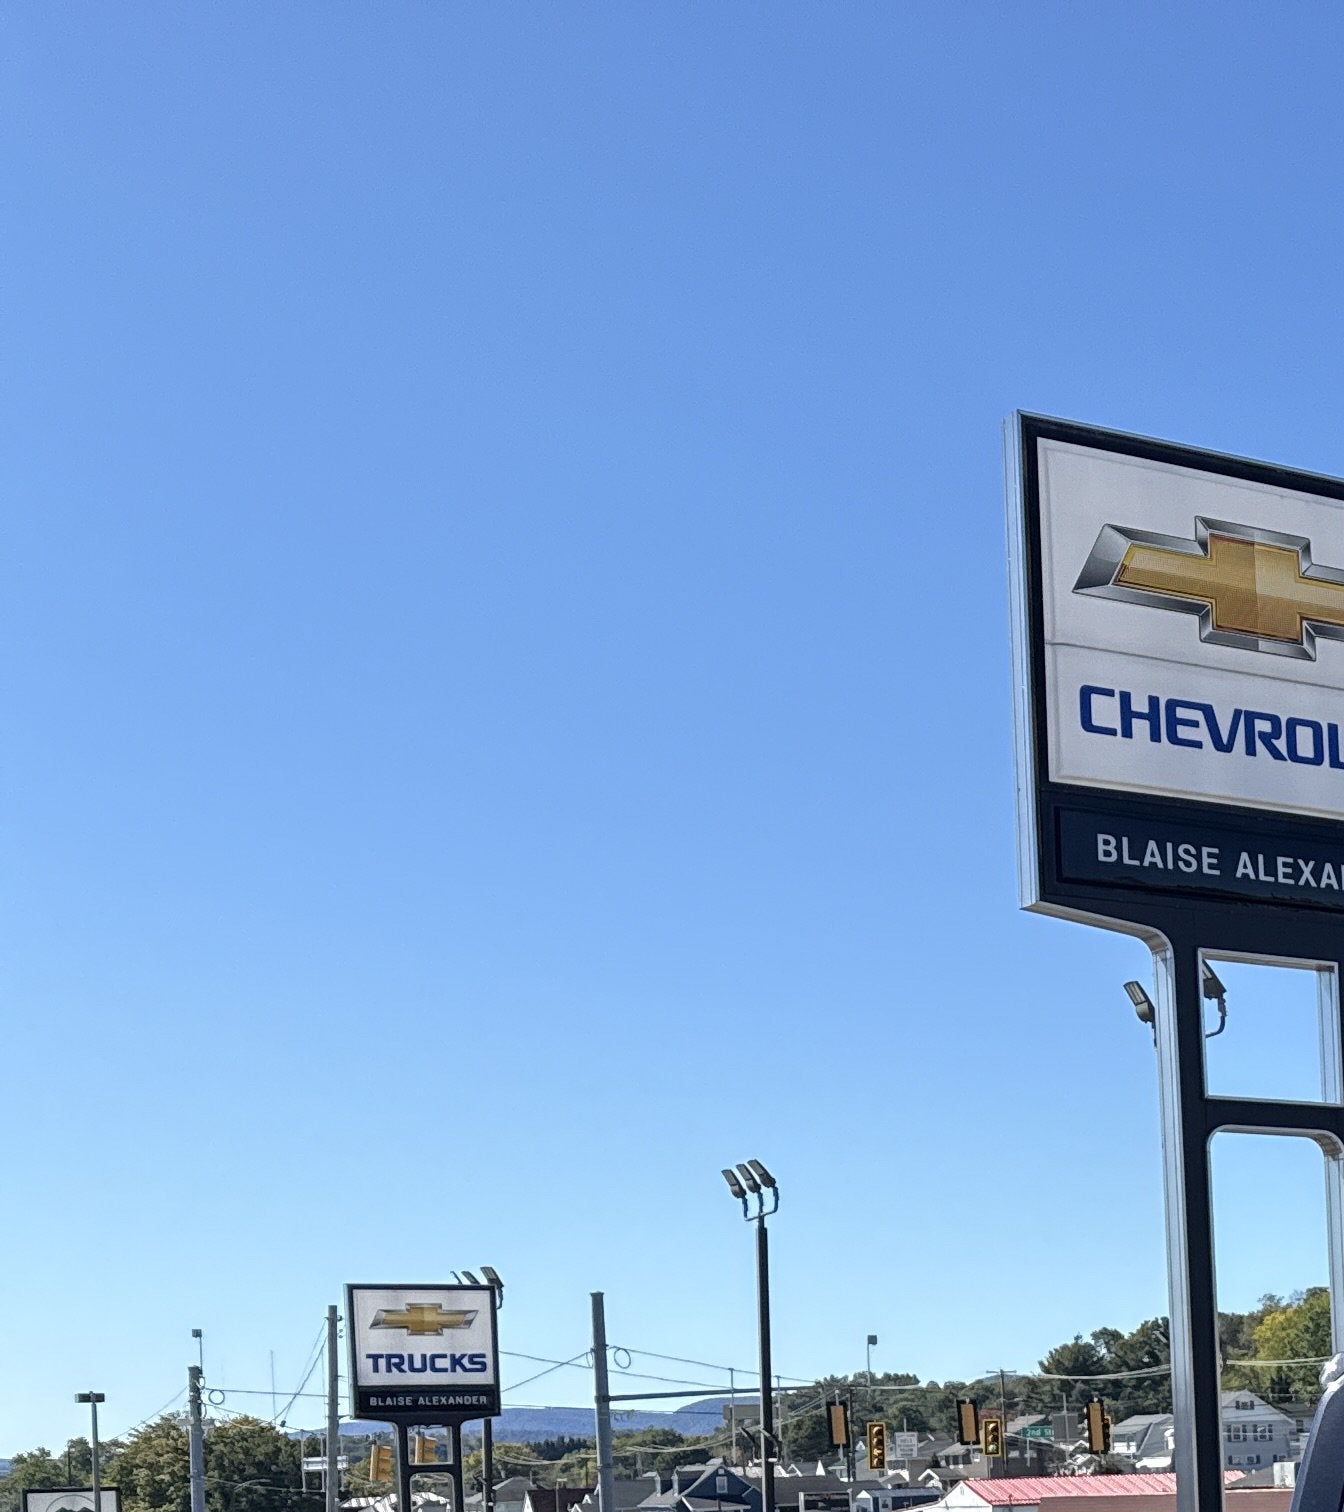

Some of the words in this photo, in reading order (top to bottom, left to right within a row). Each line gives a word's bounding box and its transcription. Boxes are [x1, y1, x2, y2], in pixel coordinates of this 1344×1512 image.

[1096, 832, 1222, 877] BLAISE
[366, 1353, 488, 1374] TRUCKS
[369, 1396, 413, 1406] BLAISE
[418, 1395, 488, 1405] ALEXANDER
